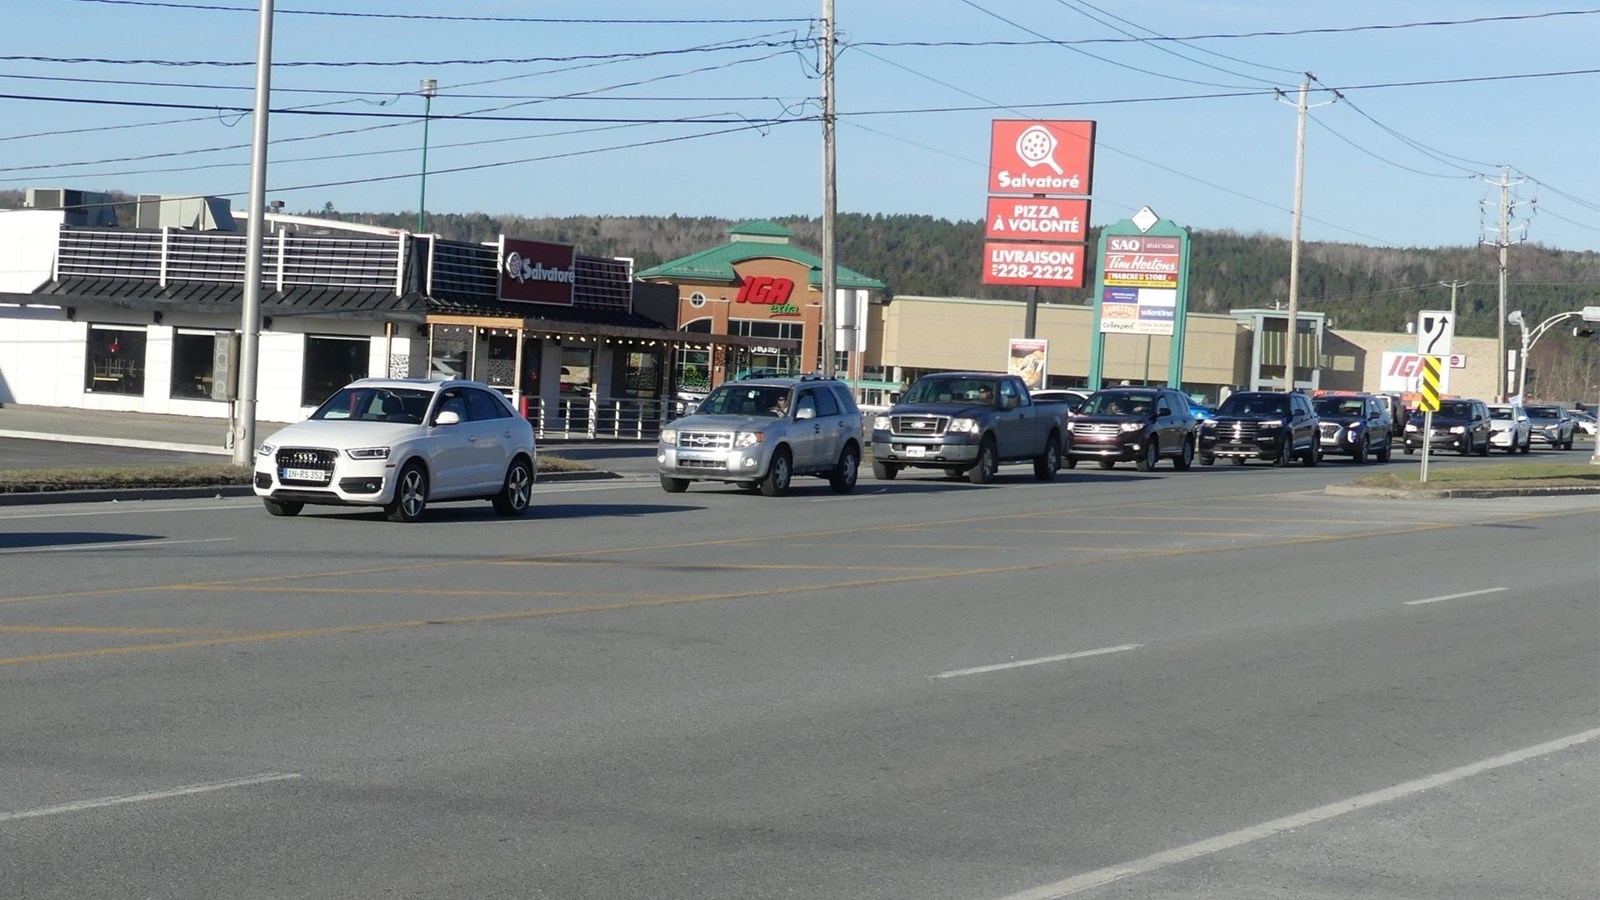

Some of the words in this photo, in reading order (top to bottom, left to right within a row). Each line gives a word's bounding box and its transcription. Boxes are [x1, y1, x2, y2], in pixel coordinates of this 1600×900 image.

[998, 170, 1080, 189] Salvatoré
[1014, 205, 1059, 218] PIZZA
[992, 213, 1005, 231] À
[1008, 216, 1080, 234] VOLONTÉ
[1111, 239, 1141, 252] SAQ
[991, 249, 1075, 265] LIVRAISON
[1109, 256, 1130, 269] Tim
[1130, 255, 1176, 271] Hortons
[523, 258, 575, 283] Salvatoré
[997, 264, 1074, 280] 228-2222
[736, 275, 795, 305] IGA
[768, 304, 799, 314] extra
[289, 470, 309, 479] IN-RS
